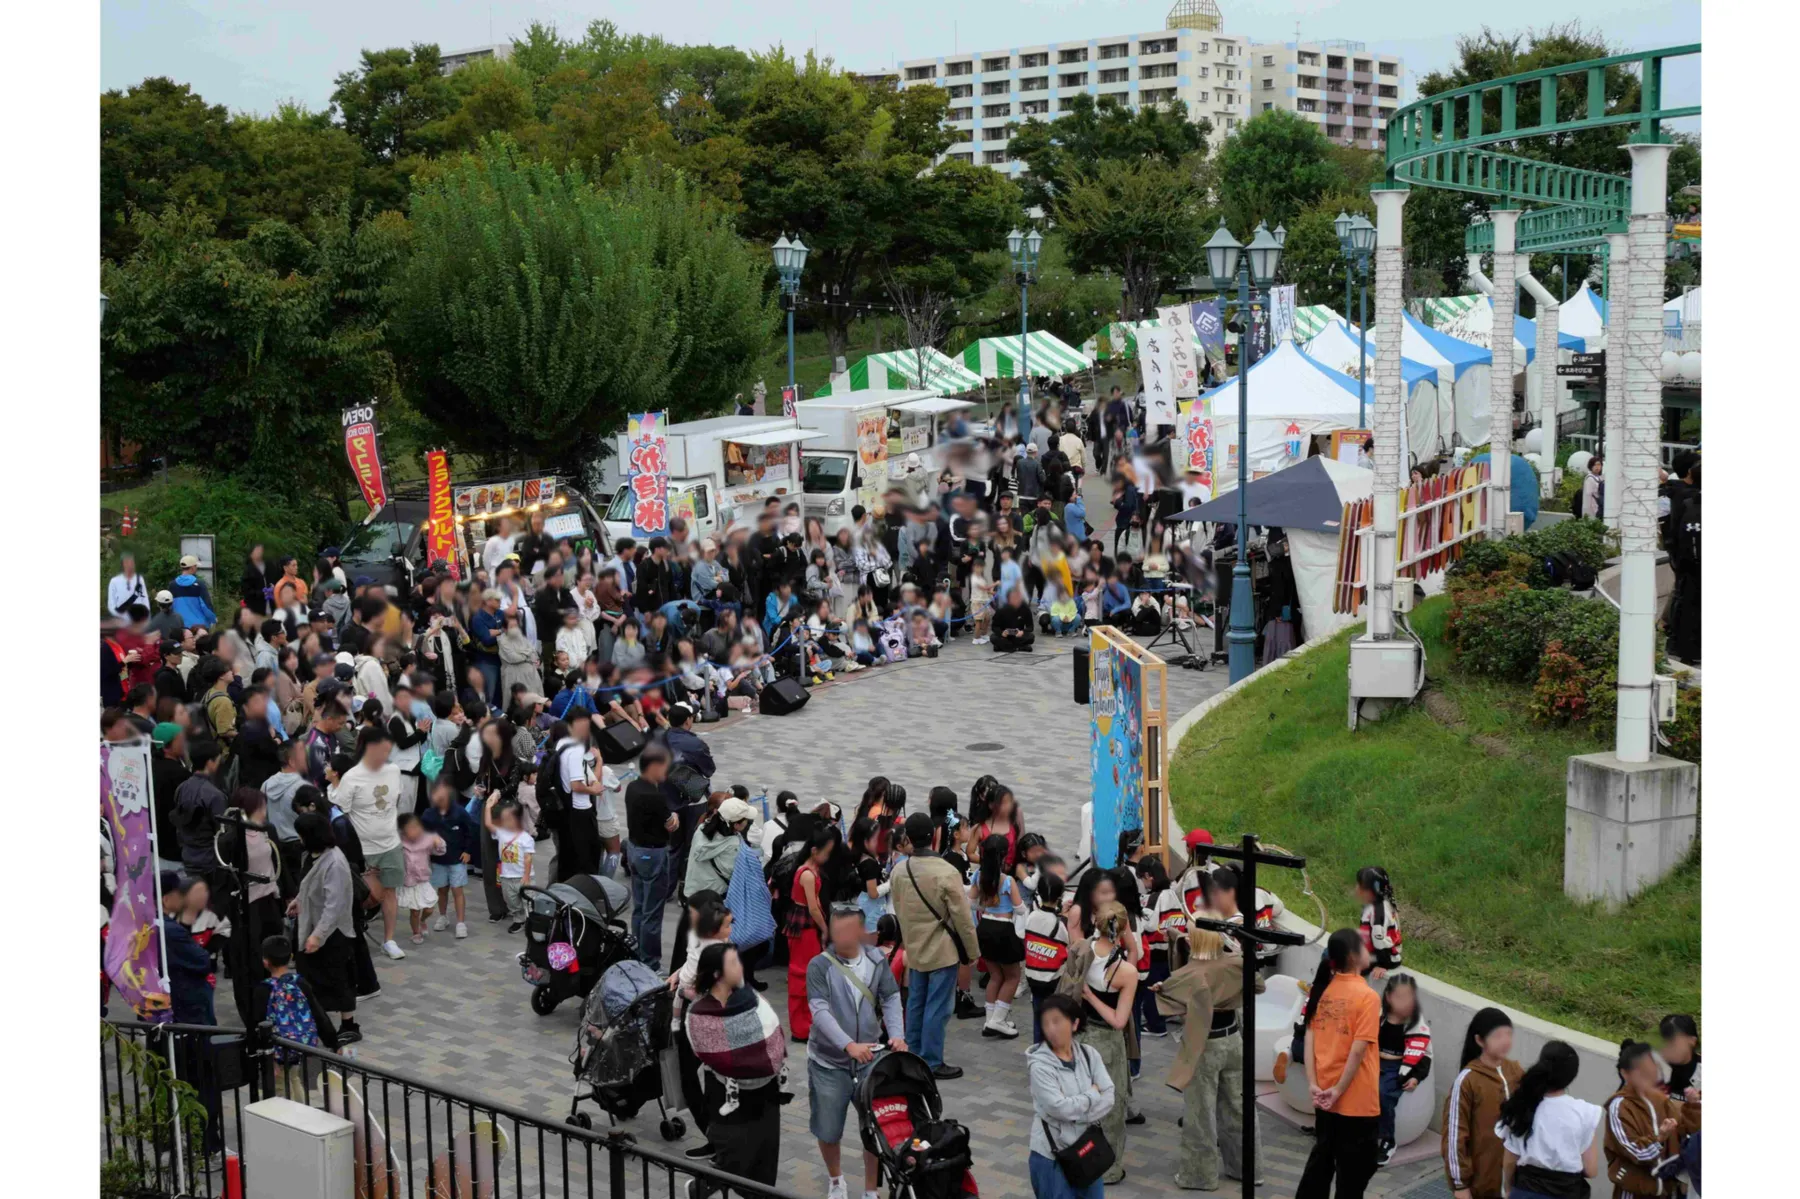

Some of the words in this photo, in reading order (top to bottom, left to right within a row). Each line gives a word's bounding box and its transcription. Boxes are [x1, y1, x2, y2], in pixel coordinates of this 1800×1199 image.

[431, 454, 454, 550] フランクフルト
